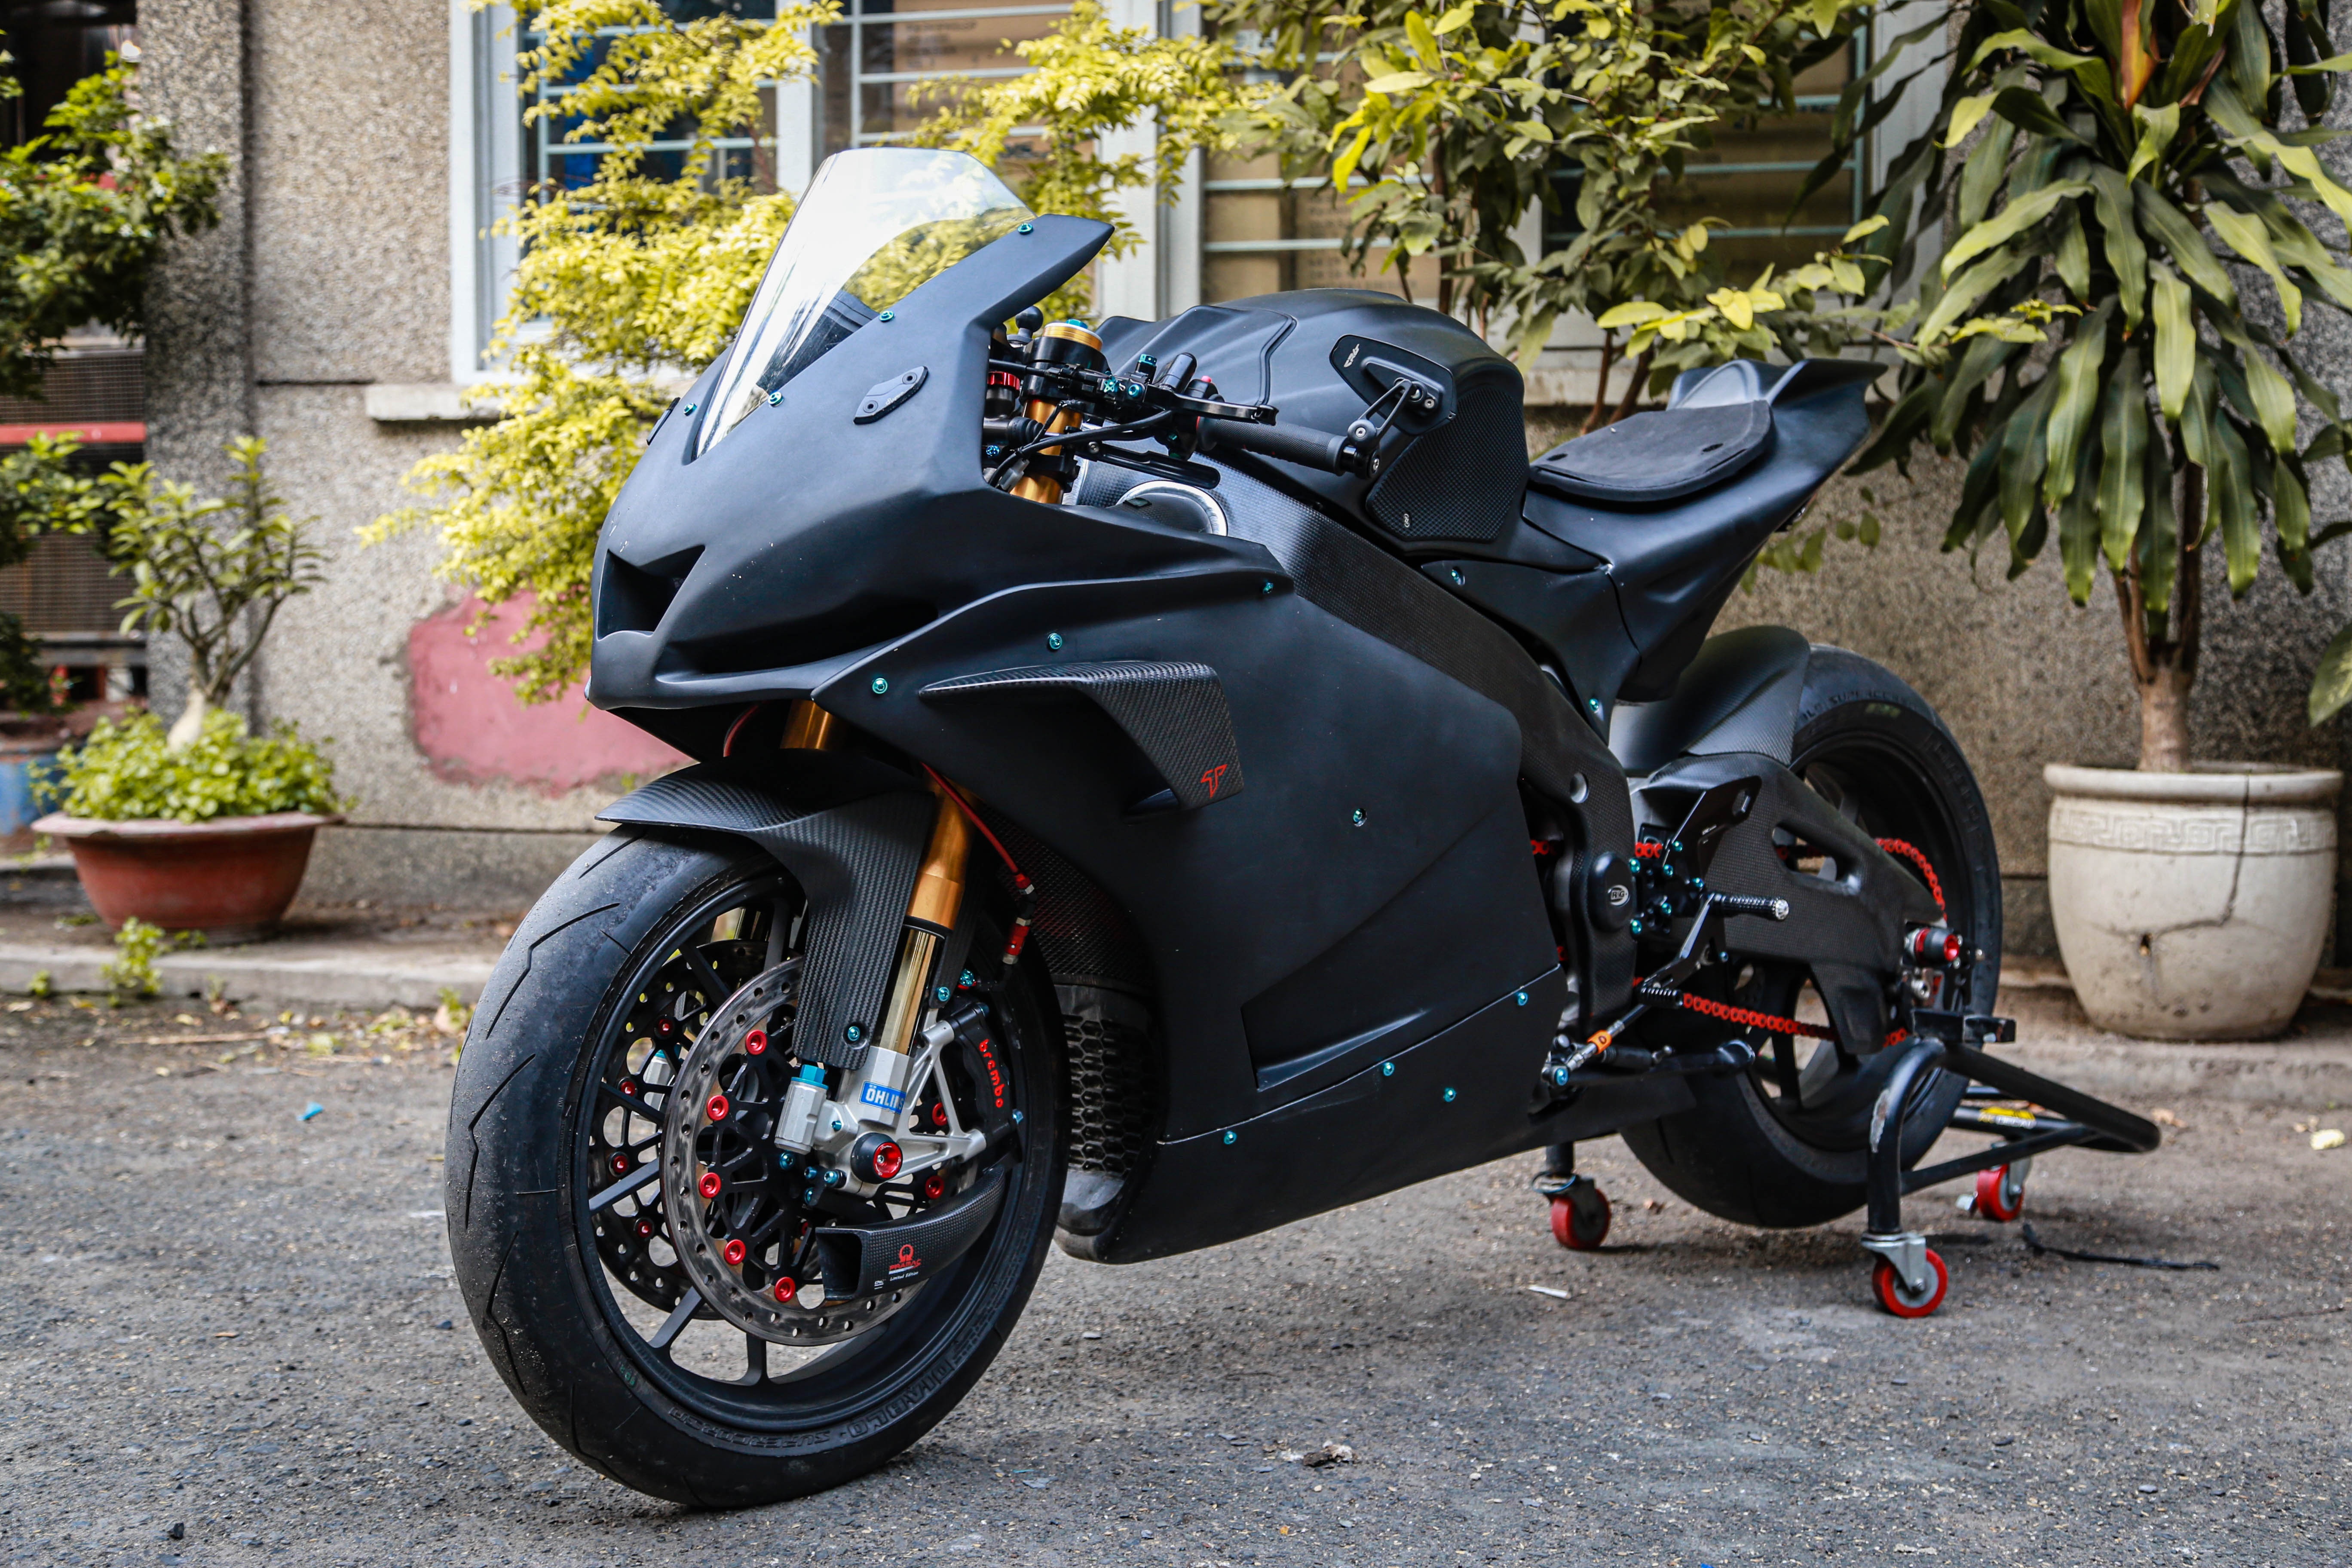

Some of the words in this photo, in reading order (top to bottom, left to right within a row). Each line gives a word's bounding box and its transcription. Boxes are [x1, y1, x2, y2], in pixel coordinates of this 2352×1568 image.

[865, 1084, 904, 1110] ÖHLINS
[979, 1038, 1005, 1108] brembo
[848, 1360, 955, 1438] DIABLO
